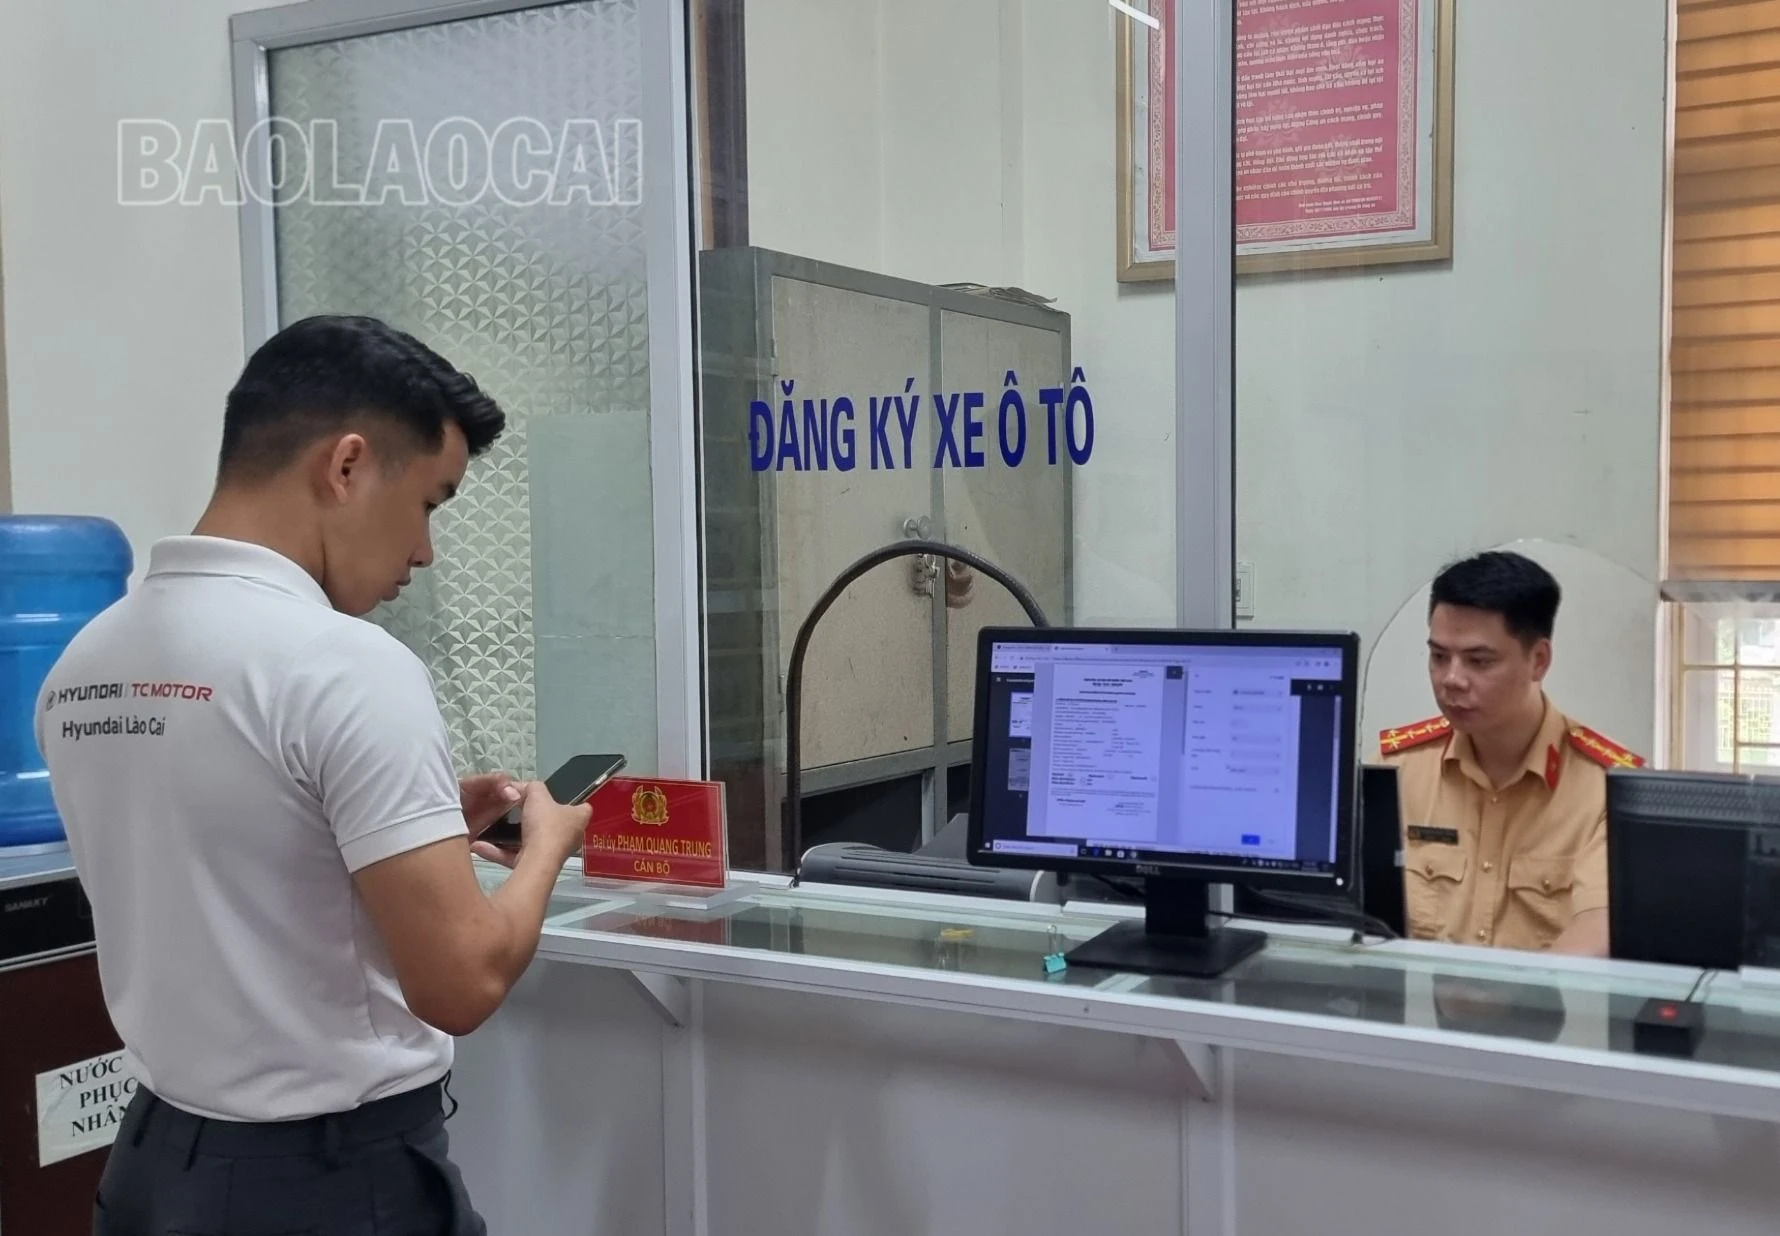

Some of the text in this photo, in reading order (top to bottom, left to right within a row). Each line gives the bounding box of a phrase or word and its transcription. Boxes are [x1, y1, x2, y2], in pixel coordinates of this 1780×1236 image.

[748, 366, 1095, 473] ĐĂNG KÝ XE Ô TÔ
[57, 682, 123, 704] HYUNDAI
[62, 714, 166, 741] Hyundai Lào Cai
[592, 834, 605, 852] Đại
[617, 835, 644, 855] PHẠM
[646, 837, 679, 855] QUANG
[680, 839, 712, 858] TRUNG
[634, 858, 670, 875] CÁN BỘ
[59, 1056, 123, 1089] NƯỚC
[80, 1076, 138, 1109] PHỤC
